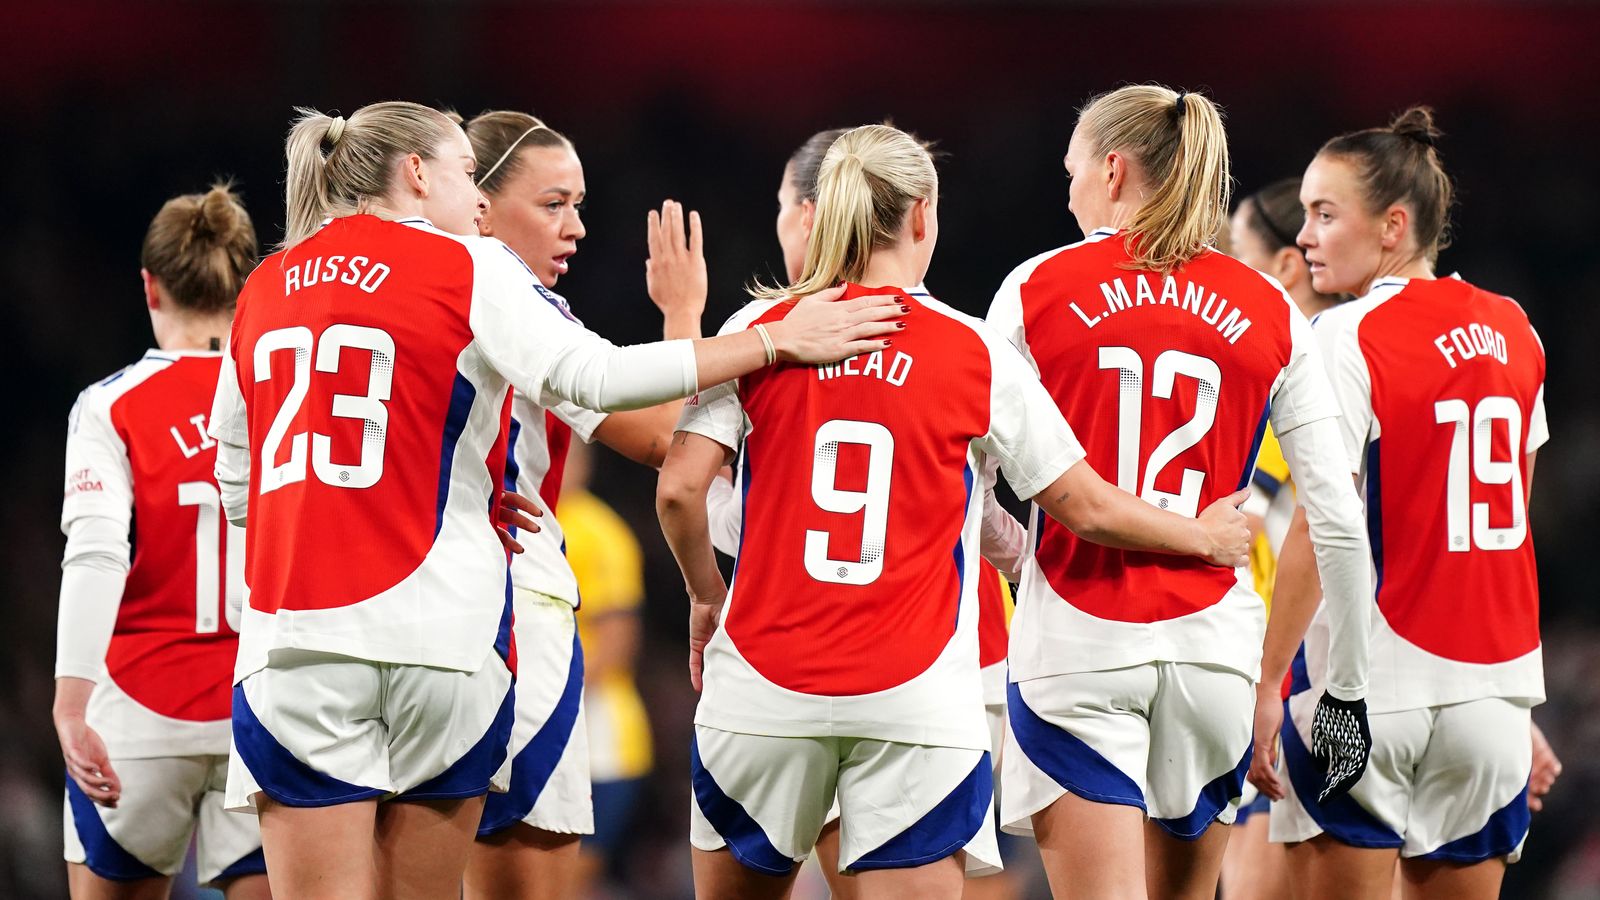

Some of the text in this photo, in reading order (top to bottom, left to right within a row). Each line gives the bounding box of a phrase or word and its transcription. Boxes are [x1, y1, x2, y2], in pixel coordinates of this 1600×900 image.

[285, 255, 391, 297] RUSSO
[1069, 274, 1252, 345] L.MAANUM
[817, 350, 914, 387] MEAD
[1434, 323, 1508, 368] FOORD
[170, 414, 217, 459] LI
[253, 323, 396, 495] 23
[1098, 346, 1222, 518] 12
[803, 419, 895, 586] 9
[1434, 396, 1527, 552] 19
